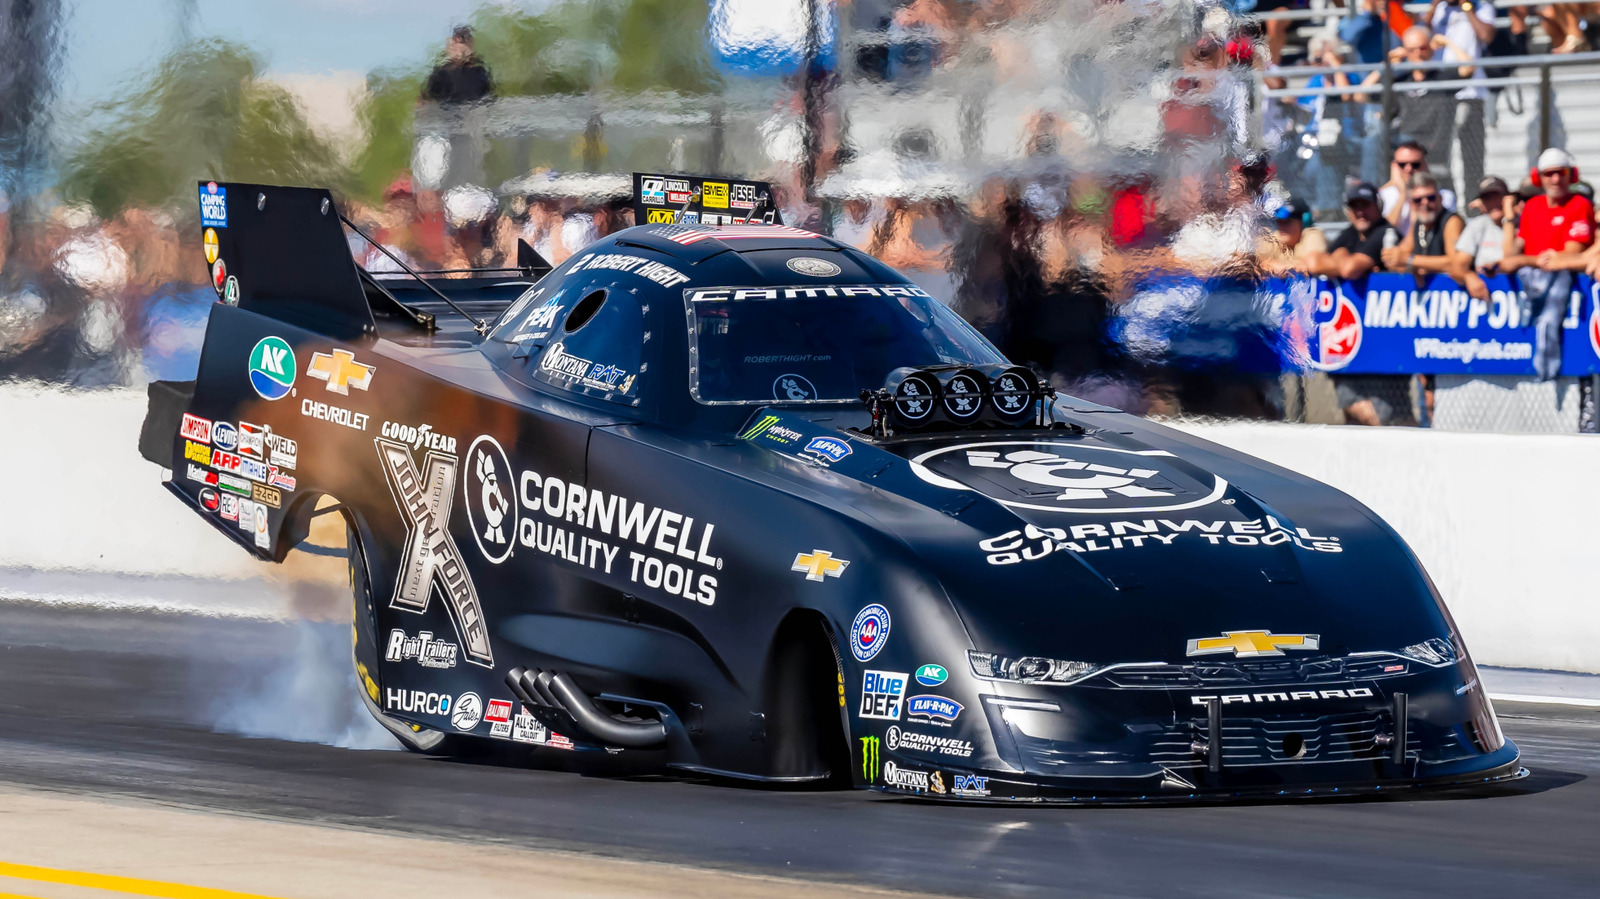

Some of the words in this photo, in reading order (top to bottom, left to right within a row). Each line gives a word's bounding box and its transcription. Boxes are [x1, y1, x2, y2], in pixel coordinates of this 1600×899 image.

[665, 181, 688, 192] LINCOLN
[704, 184, 723, 196] BME
[731, 184, 757, 202] JESEL
[200, 193, 225, 206] CAMPING
[202, 205, 226, 220] WORLD
[565, 253, 595, 276] 2
[582, 254, 649, 272] ROBERT
[633, 261, 691, 288] HIGHT
[690, 287, 931, 302] CAMARO
[518, 305, 565, 332] PEAK
[1363, 290, 1469, 329] MAKIN'
[260, 344, 288, 375] NK
[588, 363, 626, 384] RMT
[301, 398, 370, 431] CHEVROLET
[182, 416, 209, 440] SIMPSON
[271, 436, 297, 456] WELD
[212, 450, 240, 470] ARP
[520, 470, 716, 567] CORNWELL
[979, 514, 1330, 552] CORNWELL
[393, 459, 440, 540] JOHN
[432, 540, 482, 643] FORCE
[986, 533, 1180, 565] QUALITY
[1200, 533, 1343, 553] TOOLS
[519, 517, 620, 574] QUALITY
[629, 551, 718, 606] TOOLS
[856, 607, 883, 626] AUTOMOBILE
[880, 612, 888, 629] CLUB
[861, 623, 878, 639] AAA
[862, 632, 887, 659] CALIFORNIA
[923, 666, 942, 678] NK
[864, 673, 903, 694] Blue
[386, 687, 453, 716] HURCO
[861, 692, 900, 717] DEF
[1191, 687, 1374, 706] CAMARO
[487, 703, 510, 719] BALDWIN
[493, 722, 510, 733] FILTERS
[519, 729, 539, 740] CALLOUT
[899, 740, 937, 753] QUALITY
[940, 746, 972, 757] TOOLS
[902, 732, 974, 751] CORNWELL
[954, 773, 989, 790] RMT
